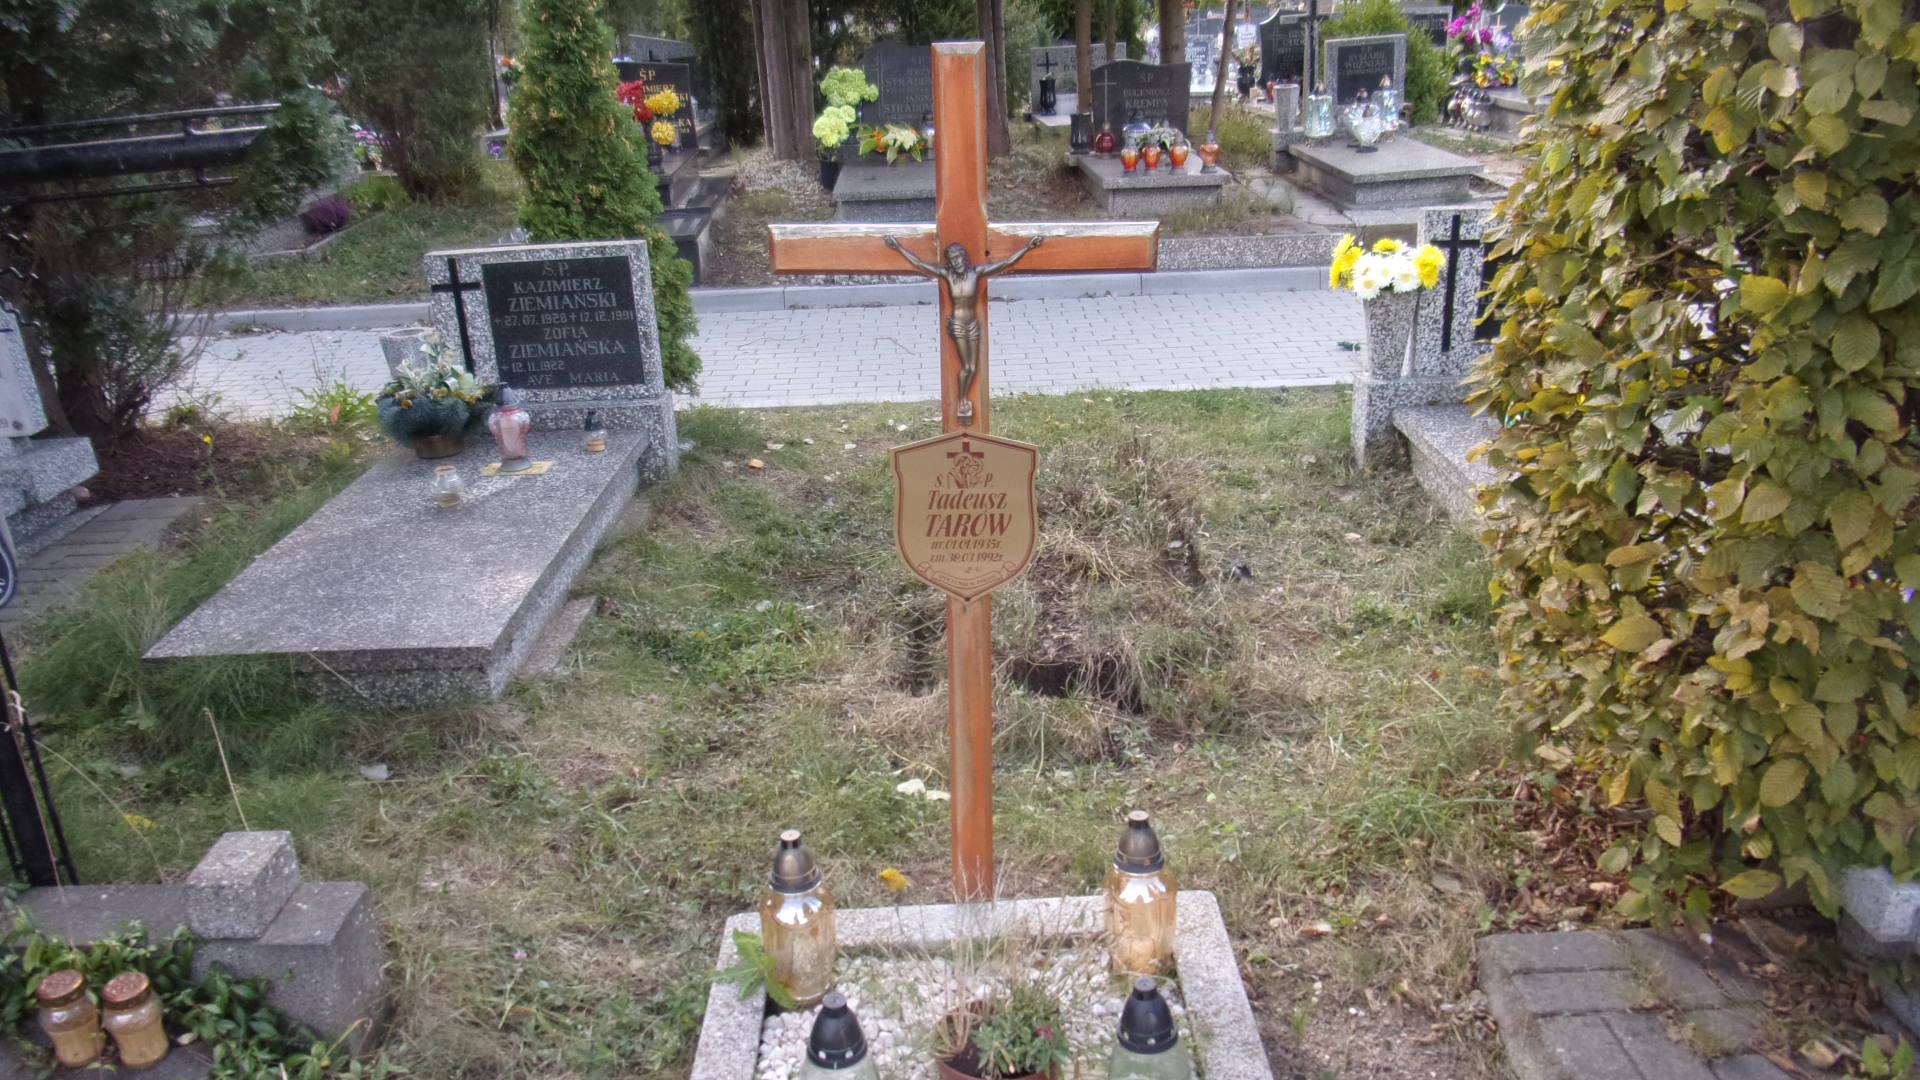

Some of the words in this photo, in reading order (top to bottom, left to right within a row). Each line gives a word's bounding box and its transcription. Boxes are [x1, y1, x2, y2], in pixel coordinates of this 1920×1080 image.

[513, 277, 604, 294] KAZIMIERZ
[507, 292, 618, 312] ZIEMIAŃSKI
[543, 326, 589, 340] ZOFIA
[508, 339, 626, 359] ZIEMIAŃSKA
[527, 374, 554, 386] AVE
[569, 371, 620, 384] MARIA
[928, 490, 1008, 510] Tadeusz
